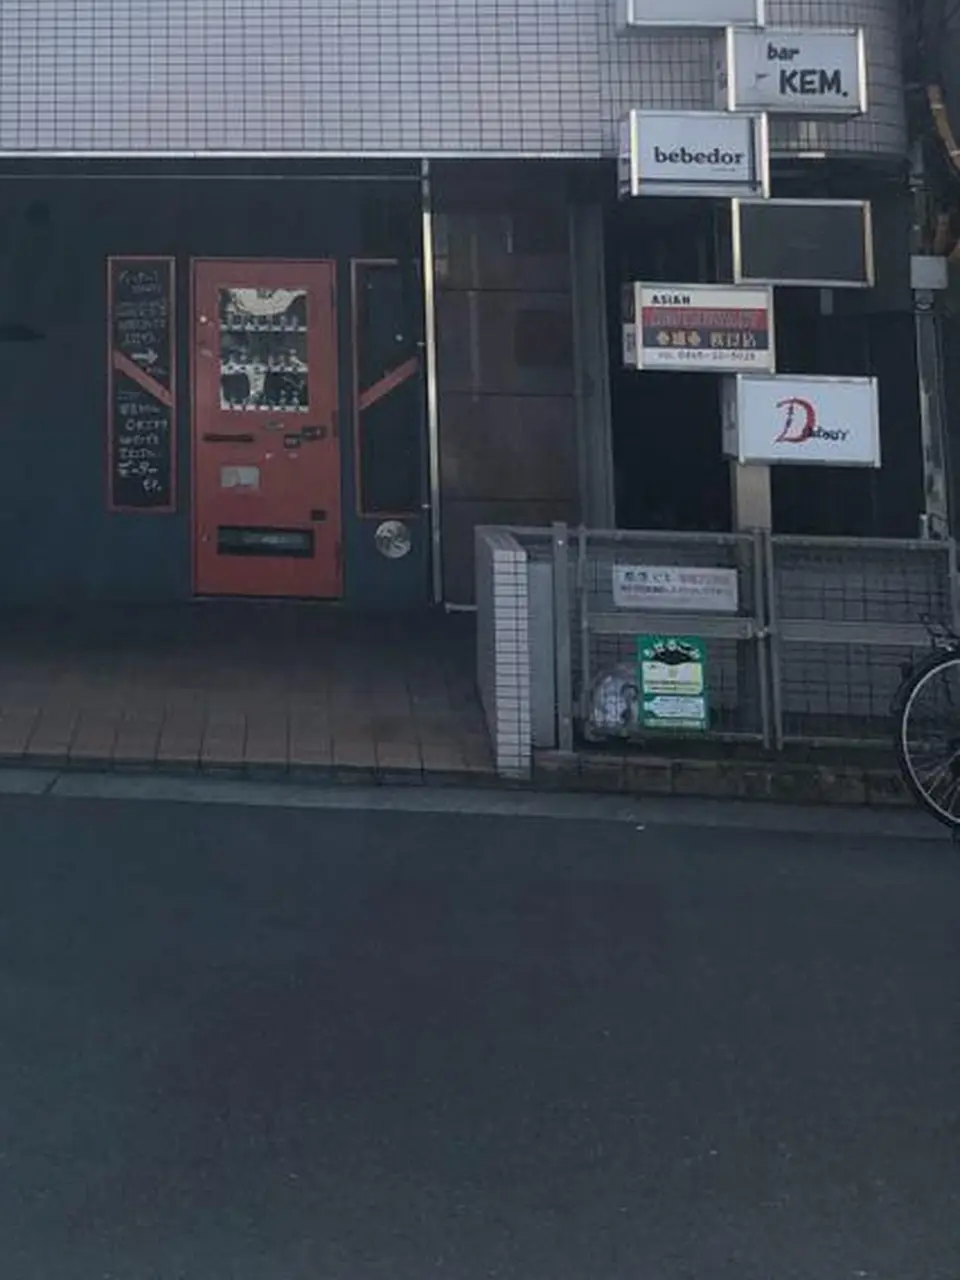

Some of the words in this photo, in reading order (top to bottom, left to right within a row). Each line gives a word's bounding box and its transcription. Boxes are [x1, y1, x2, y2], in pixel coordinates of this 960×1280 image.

[767, 43, 799, 61] bar
[654, 147, 744, 165] bebedor
[651, 294, 691, 306] ASIAN
